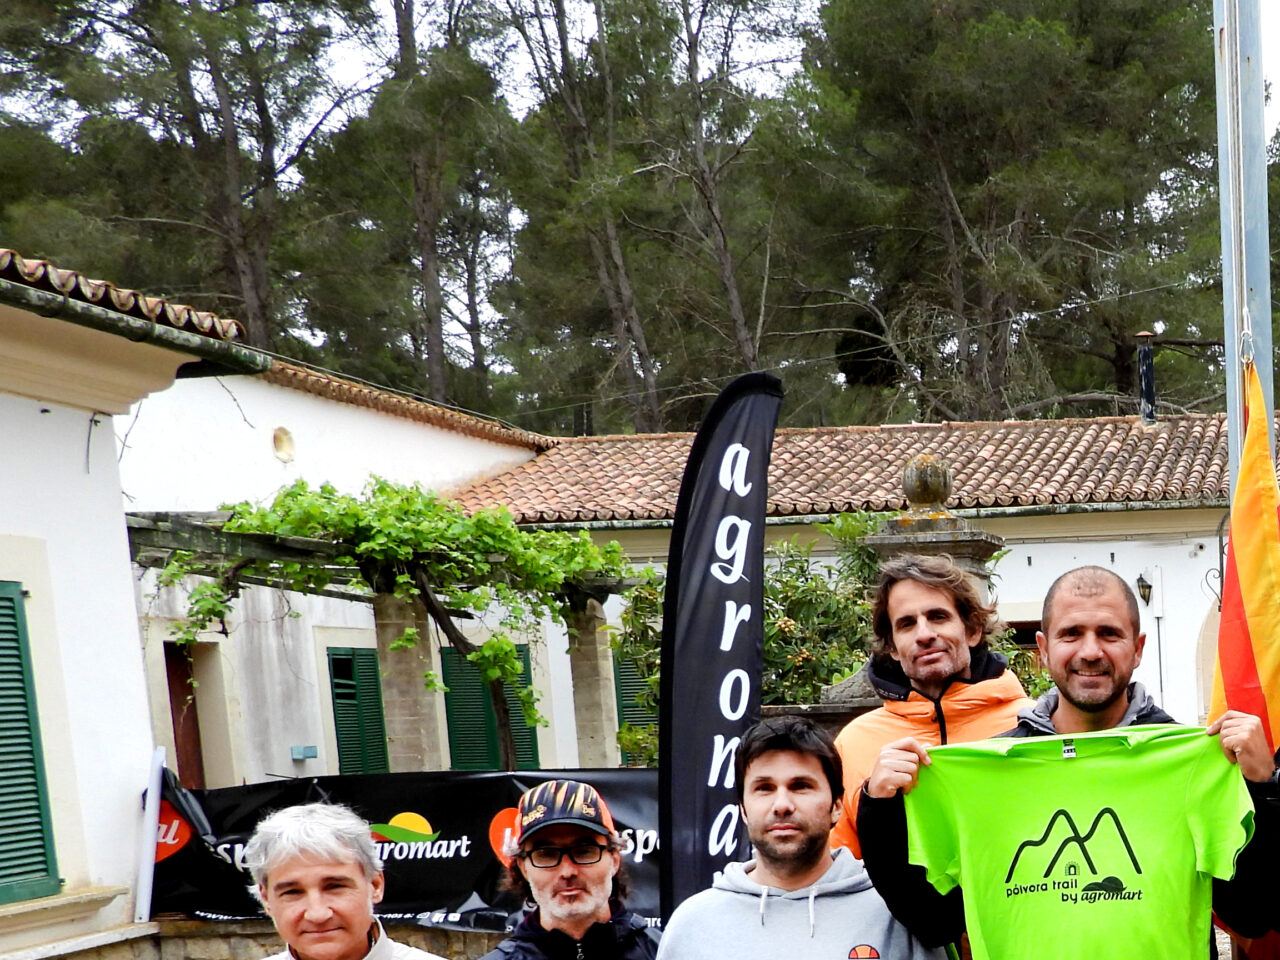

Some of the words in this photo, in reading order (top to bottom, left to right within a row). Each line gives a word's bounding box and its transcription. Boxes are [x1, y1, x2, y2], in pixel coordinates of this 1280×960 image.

[708, 442, 752, 888] agroma
[373, 835, 471, 861] romart
[1006, 882, 1048, 898] pólvora
[1052, 878, 1078, 890] trail
[1061, 892, 1078, 904] by
[1081, 889, 1143, 904] agromart
